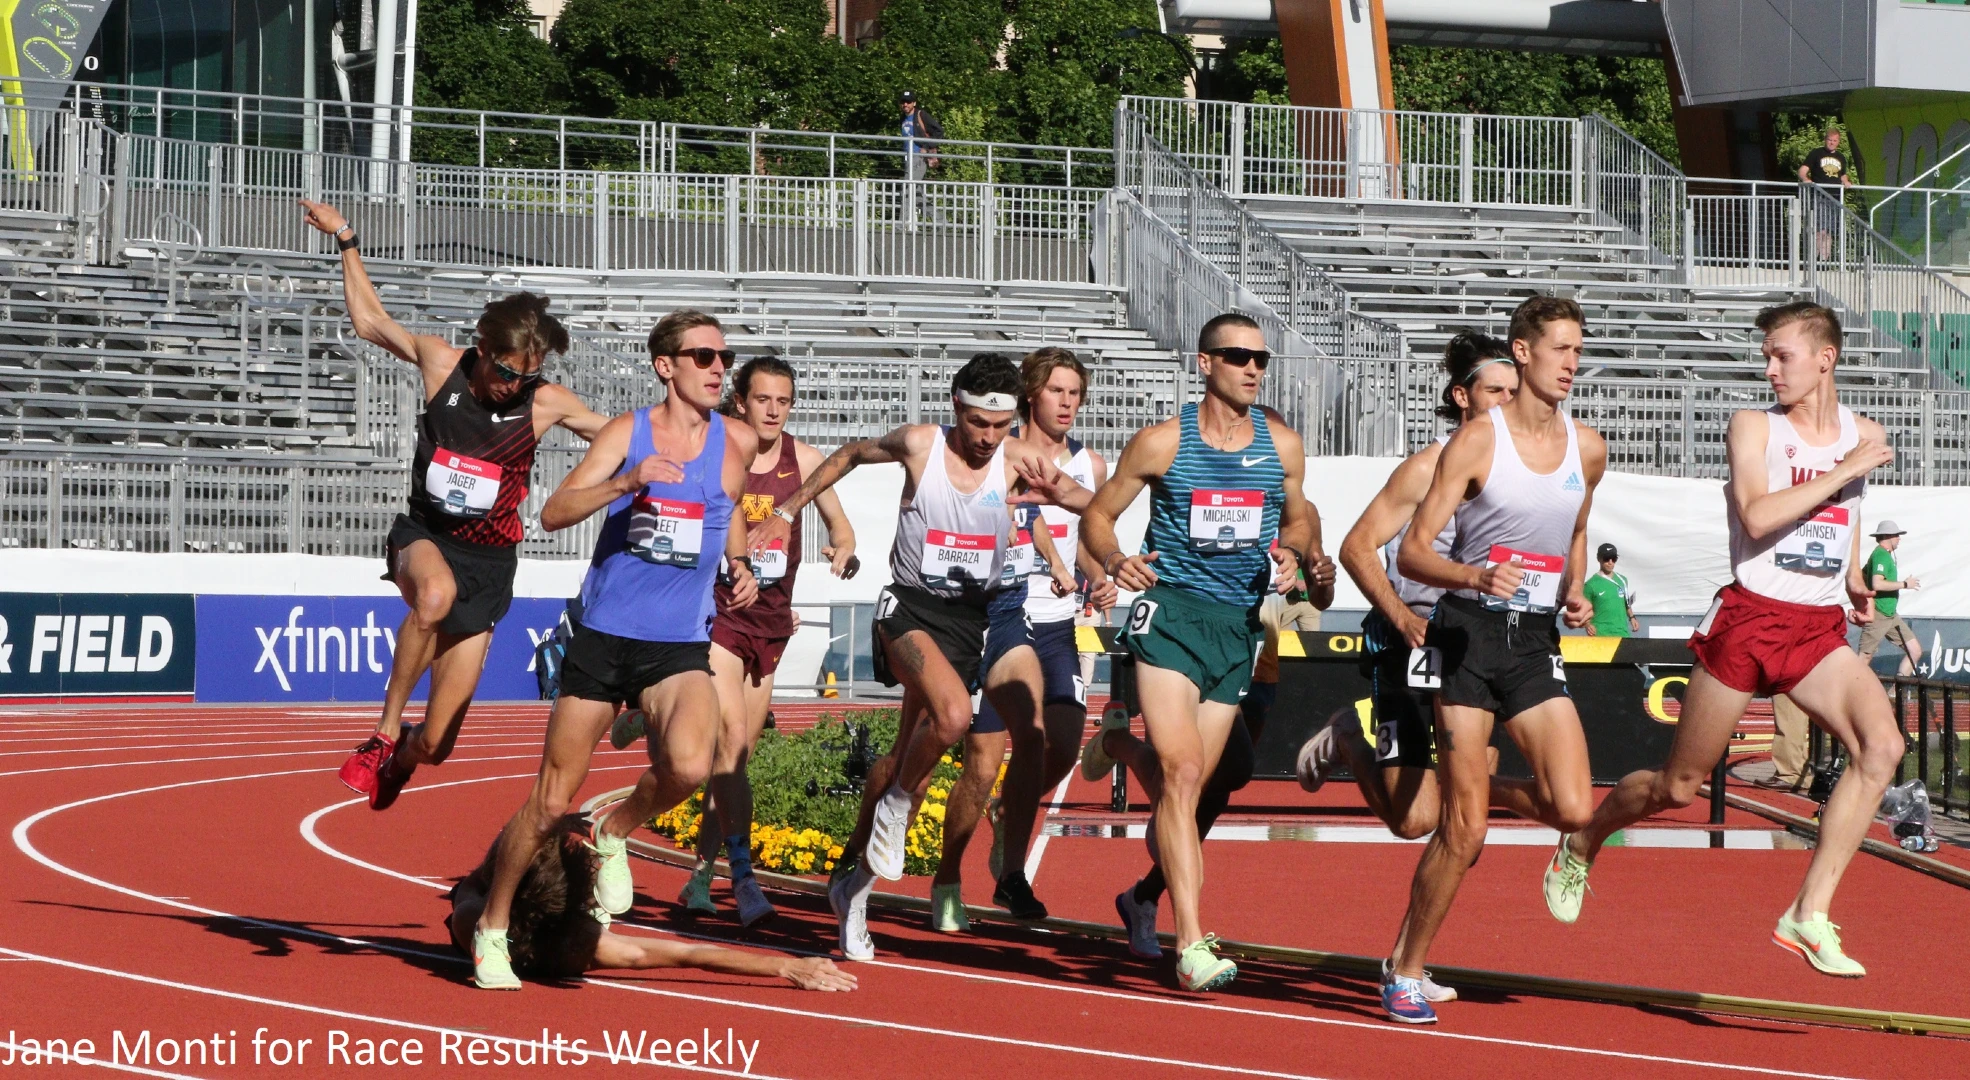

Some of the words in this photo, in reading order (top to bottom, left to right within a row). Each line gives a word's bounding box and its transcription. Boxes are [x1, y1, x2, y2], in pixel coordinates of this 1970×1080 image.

[460, 461, 482, 472] TOYOTA
[446, 472, 477, 491] JAGER
[662, 505, 687, 514] TOYOTA
[1202, 509, 1251, 523] MICHALSKI
[1795, 522, 1837, 541] JOHNSEN
[938, 548, 980, 565] BARRAZA
[1005, 547, 1024, 562] RSING
[1522, 558, 1547, 567] TOYOTA
[1522, 572, 1541, 587] RLIC
[1131, 602, 1151, 632] 9
[29, 615, 174, 673] FIELD
[1411, 649, 1436, 684] 4
[1377, 725, 1394, 757] 3
